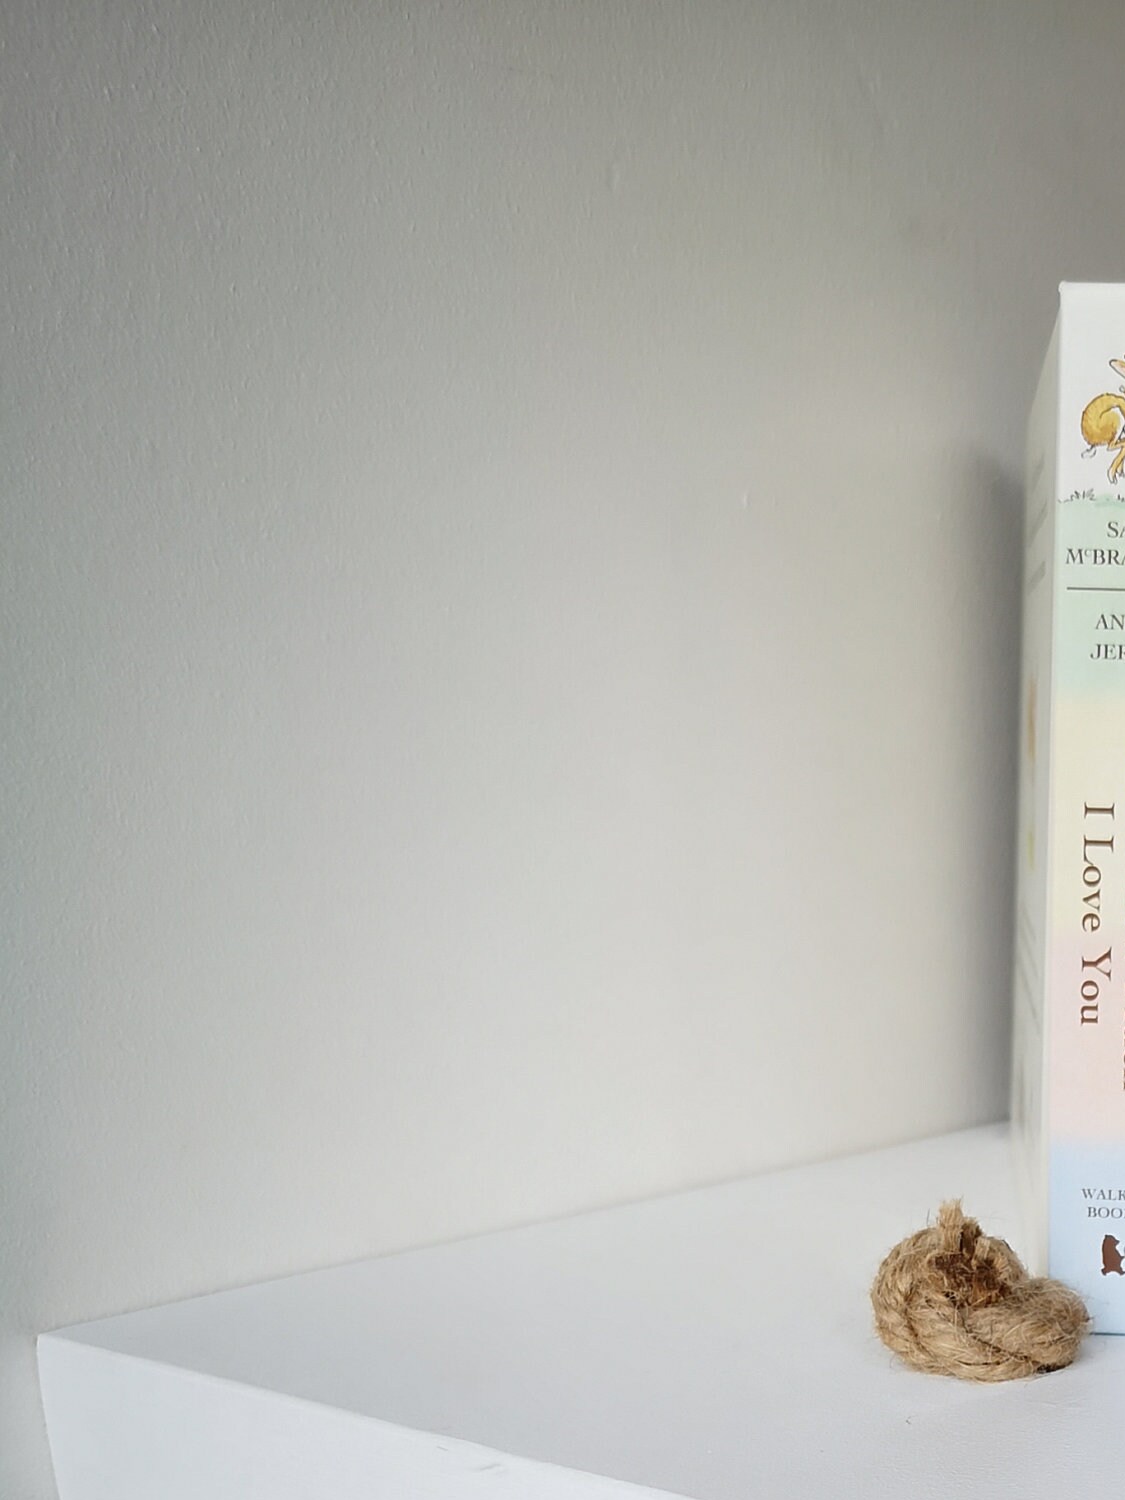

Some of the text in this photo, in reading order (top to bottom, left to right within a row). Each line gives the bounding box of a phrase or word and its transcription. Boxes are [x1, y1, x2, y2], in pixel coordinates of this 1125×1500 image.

[1080, 802, 1116, 1026] I Love You
